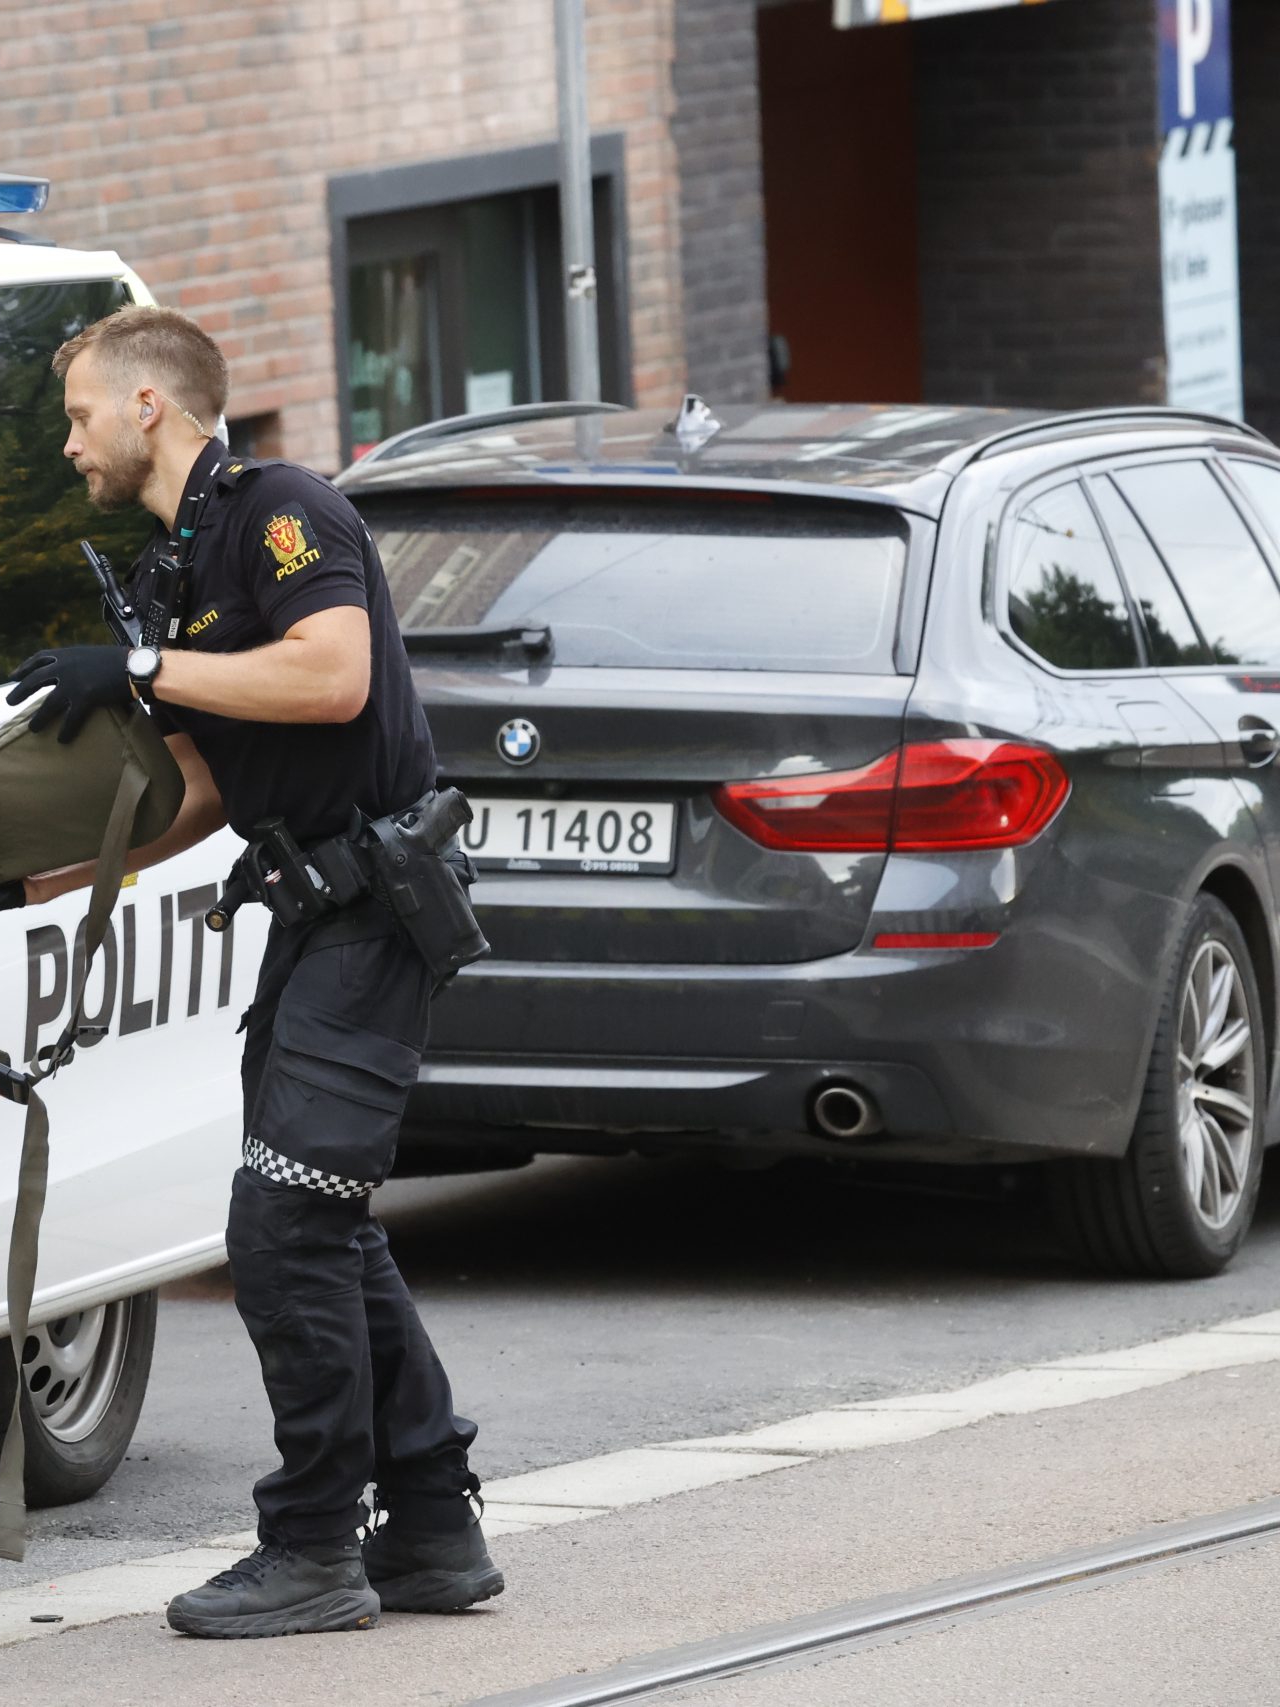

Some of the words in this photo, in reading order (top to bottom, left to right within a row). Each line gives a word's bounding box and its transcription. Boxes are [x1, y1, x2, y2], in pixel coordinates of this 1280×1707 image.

[1176, 0, 1213, 119] P
[275, 548, 321, 582] POLITI
[186, 609, 219, 637] POLITI
[516, 808, 654, 855] 11408
[23, 880, 235, 1063] POLITI
